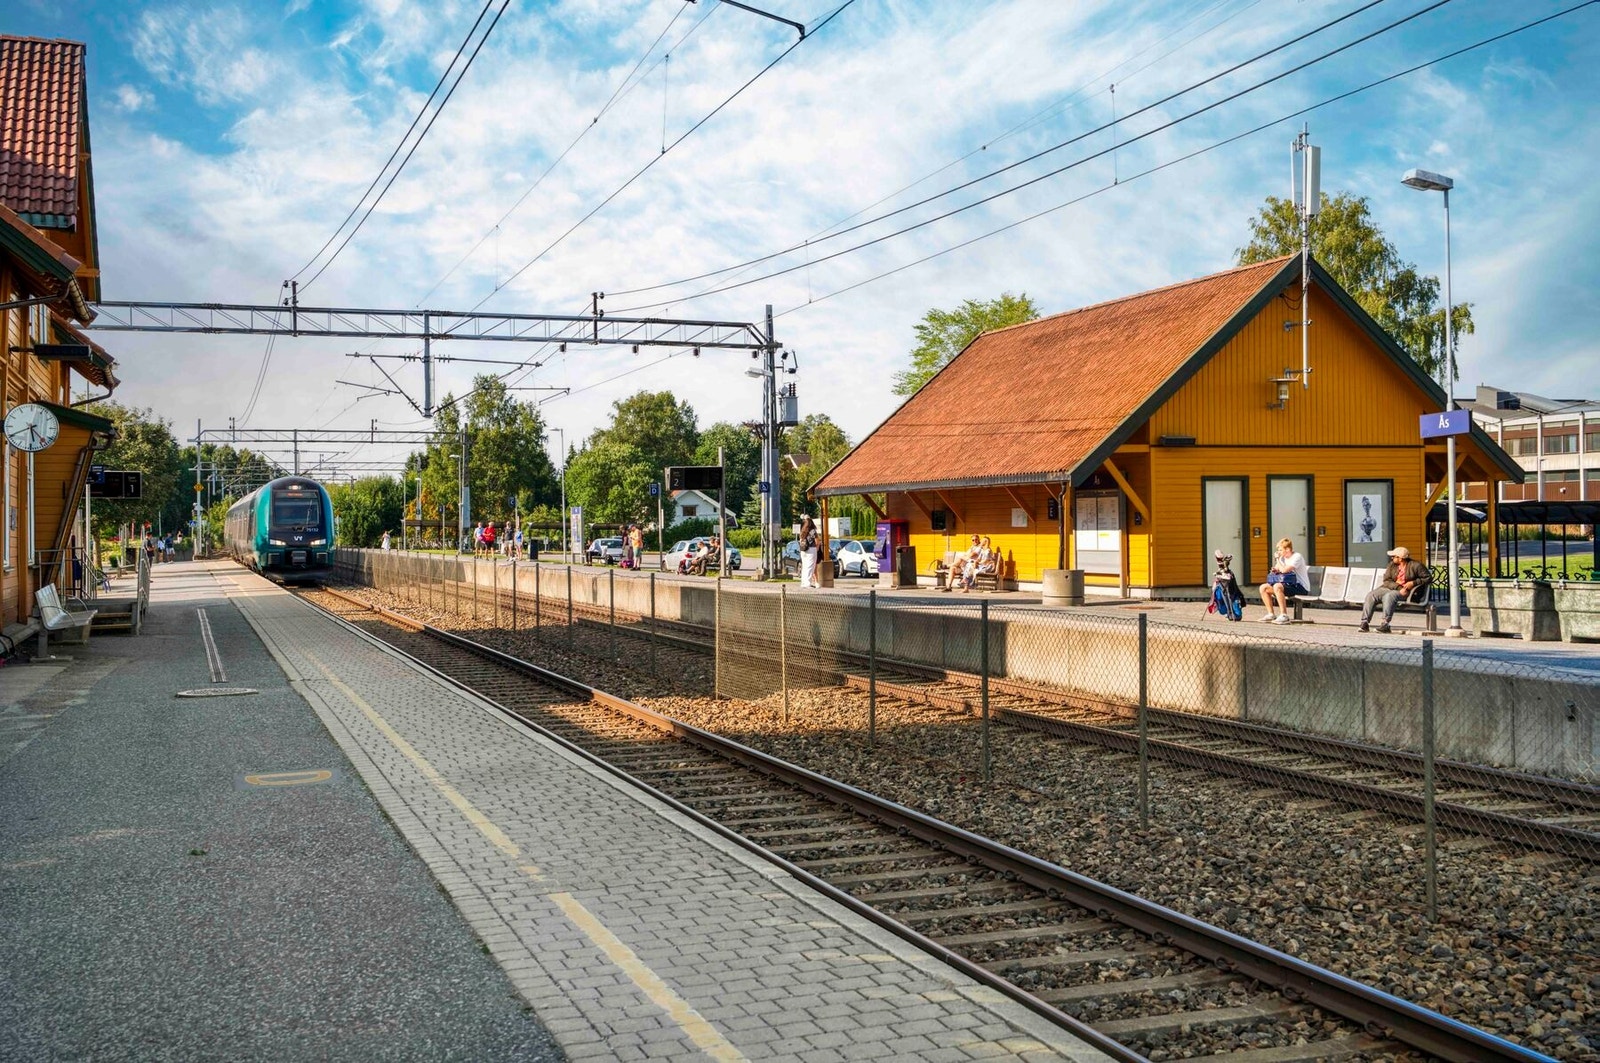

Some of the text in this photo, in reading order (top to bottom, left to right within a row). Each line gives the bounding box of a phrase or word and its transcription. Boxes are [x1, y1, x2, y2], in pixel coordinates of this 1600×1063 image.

[1438, 414, 1450, 429] Ås
[673, 478, 679, 487] 2
[129, 484, 134, 494] 1
